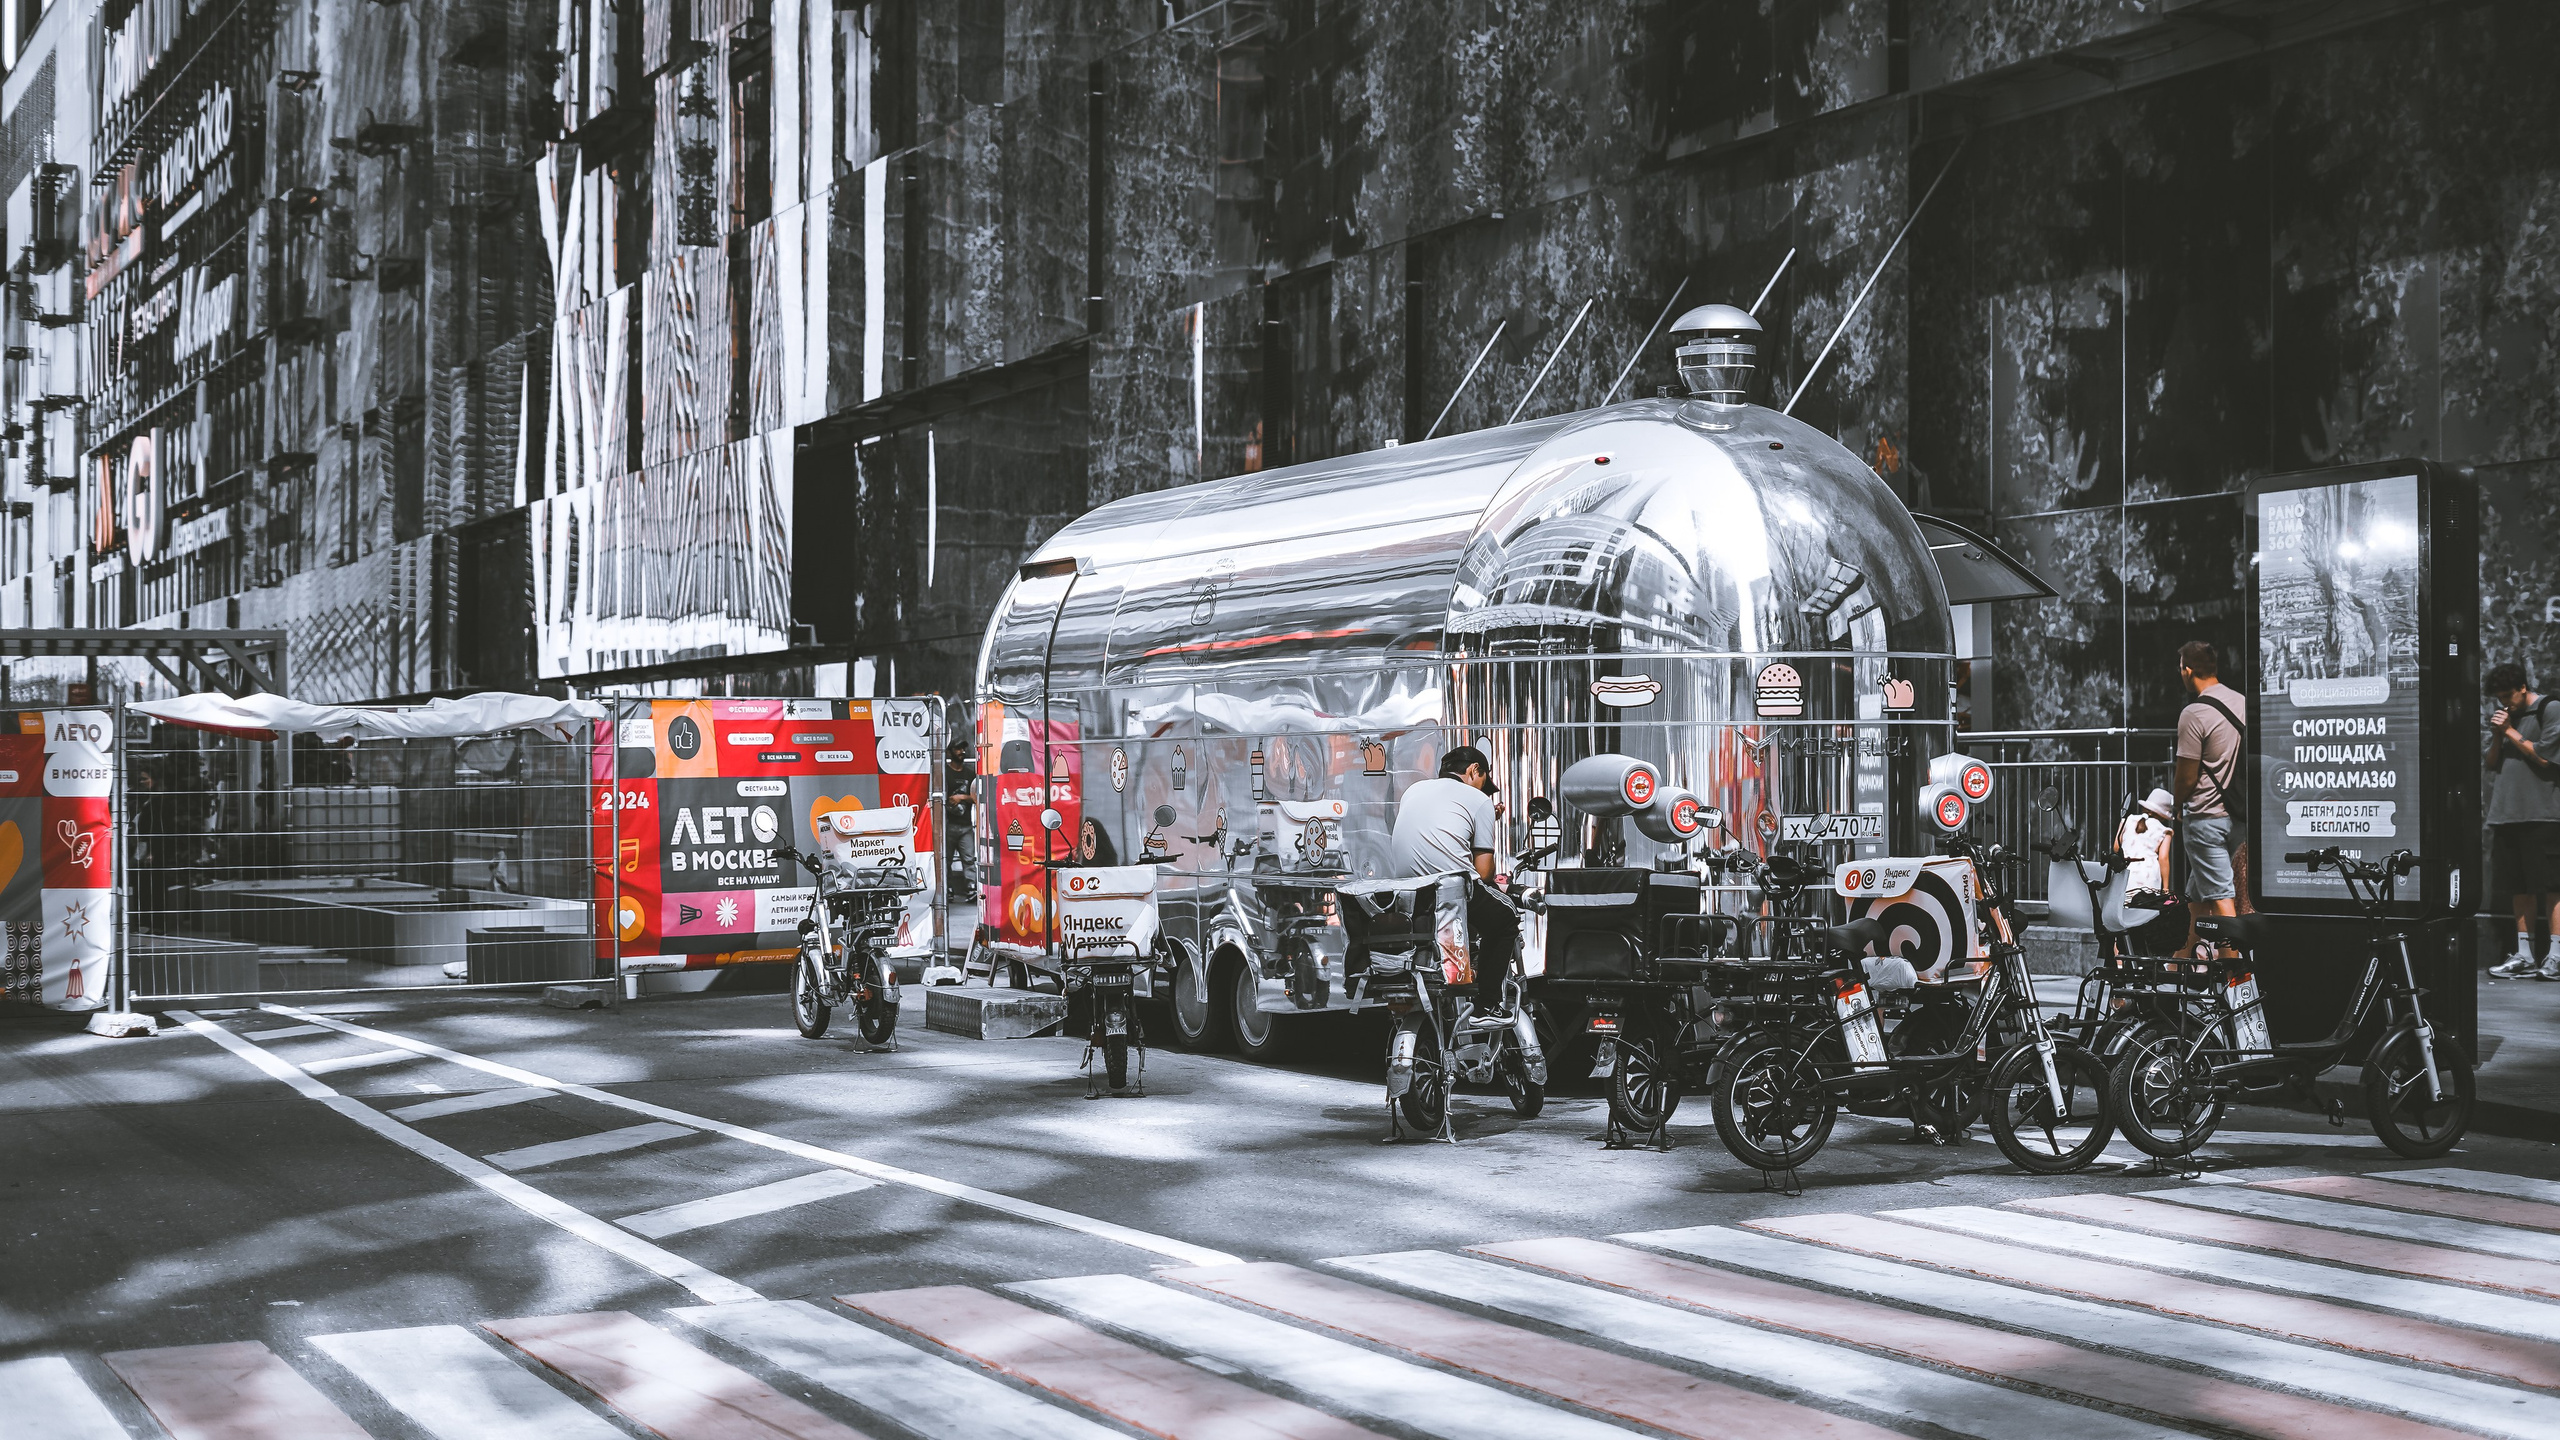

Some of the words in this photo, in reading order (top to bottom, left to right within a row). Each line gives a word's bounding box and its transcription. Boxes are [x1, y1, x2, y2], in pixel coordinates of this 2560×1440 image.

[161, 126, 195, 212] КИНО
[2268, 503, 2306, 521] PANO
[2268, 518, 2305, 535] RAMA
[2300, 685, 2380, 701] официальная
[882, 711, 923, 728] ЛЕТО
[2292, 717, 2386, 737] СМОТРОВАЯ
[54, 724, 102, 742] ЛЕТО
[884, 750, 890, 759] В
[892, 749, 926, 759] МОСКВЕ
[2294, 744, 2387, 765] ПЛОЩАДКА
[52, 769, 59, 779] В
[62, 769, 108, 779] МОСКВЕ
[2285, 770, 2397, 789] PANORAMA360
[2300, 805, 2334, 818] ДЕТЯМ
[2335, 805, 2352, 818] ДО
[2353, 805, 2359, 817] 5
[2360, 805, 2380, 817] ЛЕТ
[670, 805, 779, 845] ЛЕТО
[1862, 816, 1878, 832] 77
[2310, 821, 2370, 833] БЕСПЛАТНО
[850, 839, 885, 848] Маркет
[671, 851, 687, 871] В
[692, 848, 779, 871] МОСКВЕ
[851, 847, 896, 858] деливери
[718, 877, 735, 886] ВСЕ
[736, 876, 749, 885] НА
[749, 875, 780, 885] УЛИЦУ!
[1884, 868, 1910, 878] Яндекс
[1882, 879, 1896, 889] Еда
[771, 893, 797, 902] САМЫЙ
[771, 905, 799, 914] ЛЕТНИЙ
[777, 917, 798, 925] МИРЕ!
[1063, 914, 1124, 932] Яндекс
[1064, 933, 1127, 951] Маркет
